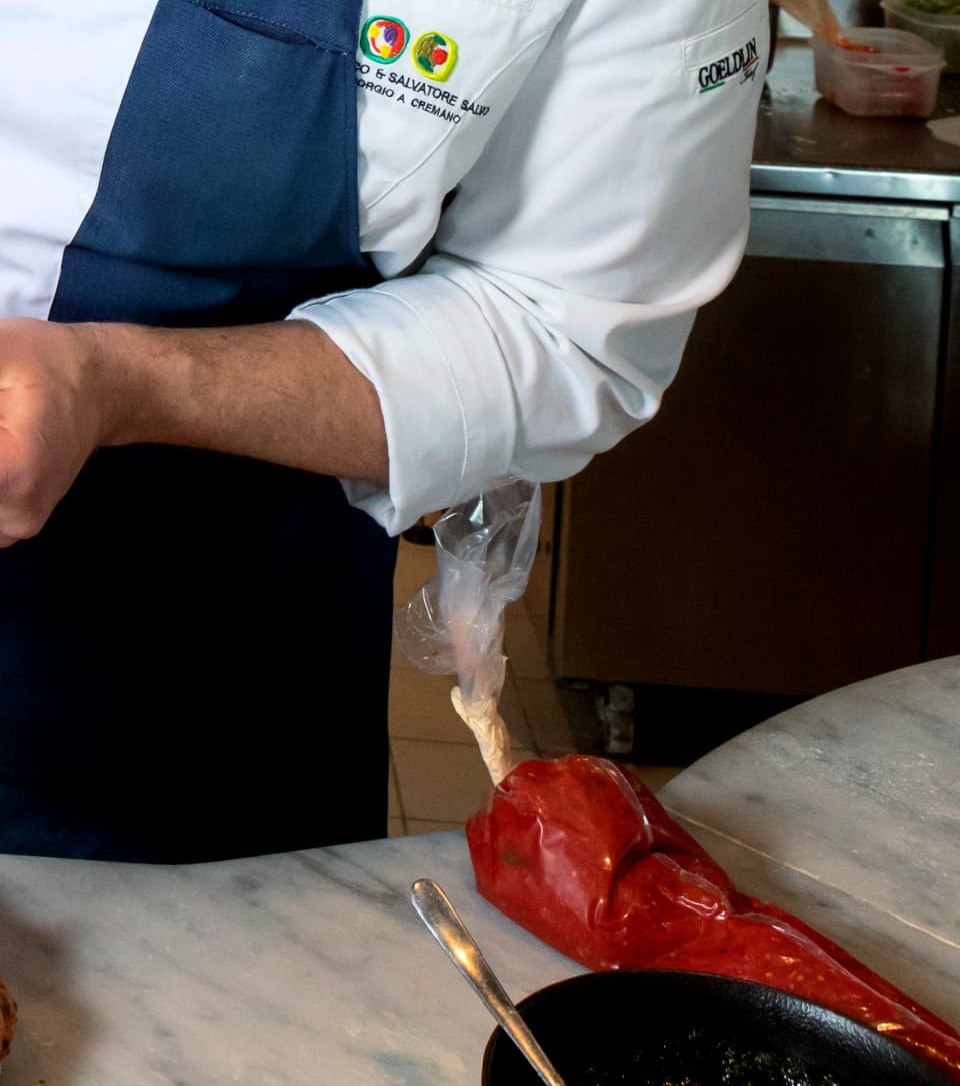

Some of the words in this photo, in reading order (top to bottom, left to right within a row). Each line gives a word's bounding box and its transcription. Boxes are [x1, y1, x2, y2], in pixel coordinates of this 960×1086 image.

[376, 68, 386, 80] &
[388, 72, 458, 107] SALVATORE
[396, 93, 406, 104] A
[410, 98, 462, 124] CREMANO
